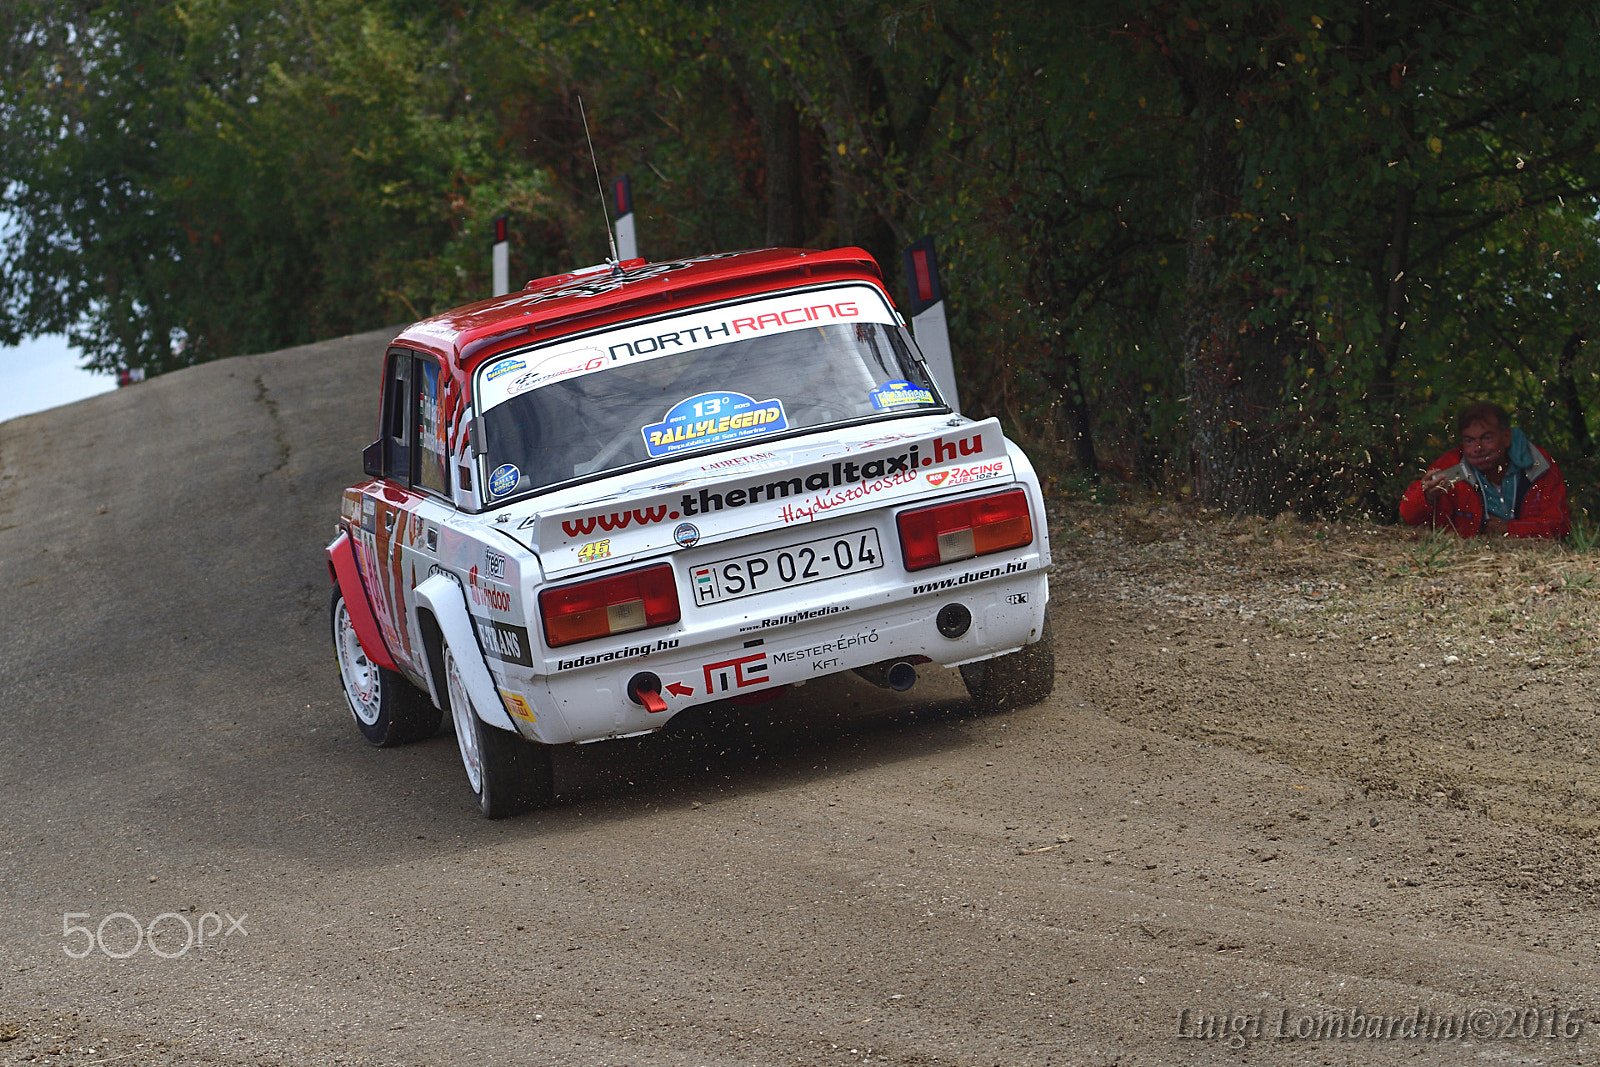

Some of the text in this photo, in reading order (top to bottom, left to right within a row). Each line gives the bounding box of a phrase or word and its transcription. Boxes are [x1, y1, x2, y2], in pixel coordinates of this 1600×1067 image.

[649, 407, 781, 447] RALLYLEGEND
[667, 426, 767, 452] Repubblica di San Marino
[701, 451, 777, 472] LAURETANA
[950, 461, 1004, 479] RACING
[494, 474, 514, 488] RALLY
[562, 433, 984, 538] www.thermaltaxi.hu
[928, 473, 943, 482] MOL
[947, 476, 975, 486] FUEL
[578, 538, 611, 558] 46
[722, 535, 876, 594] SP 02-04
[912, 561, 1028, 595] www.duen.hu
[478, 581, 512, 613] windoor
[699, 584, 715, 602] H
[557, 638, 680, 671] ladaracing.hu
